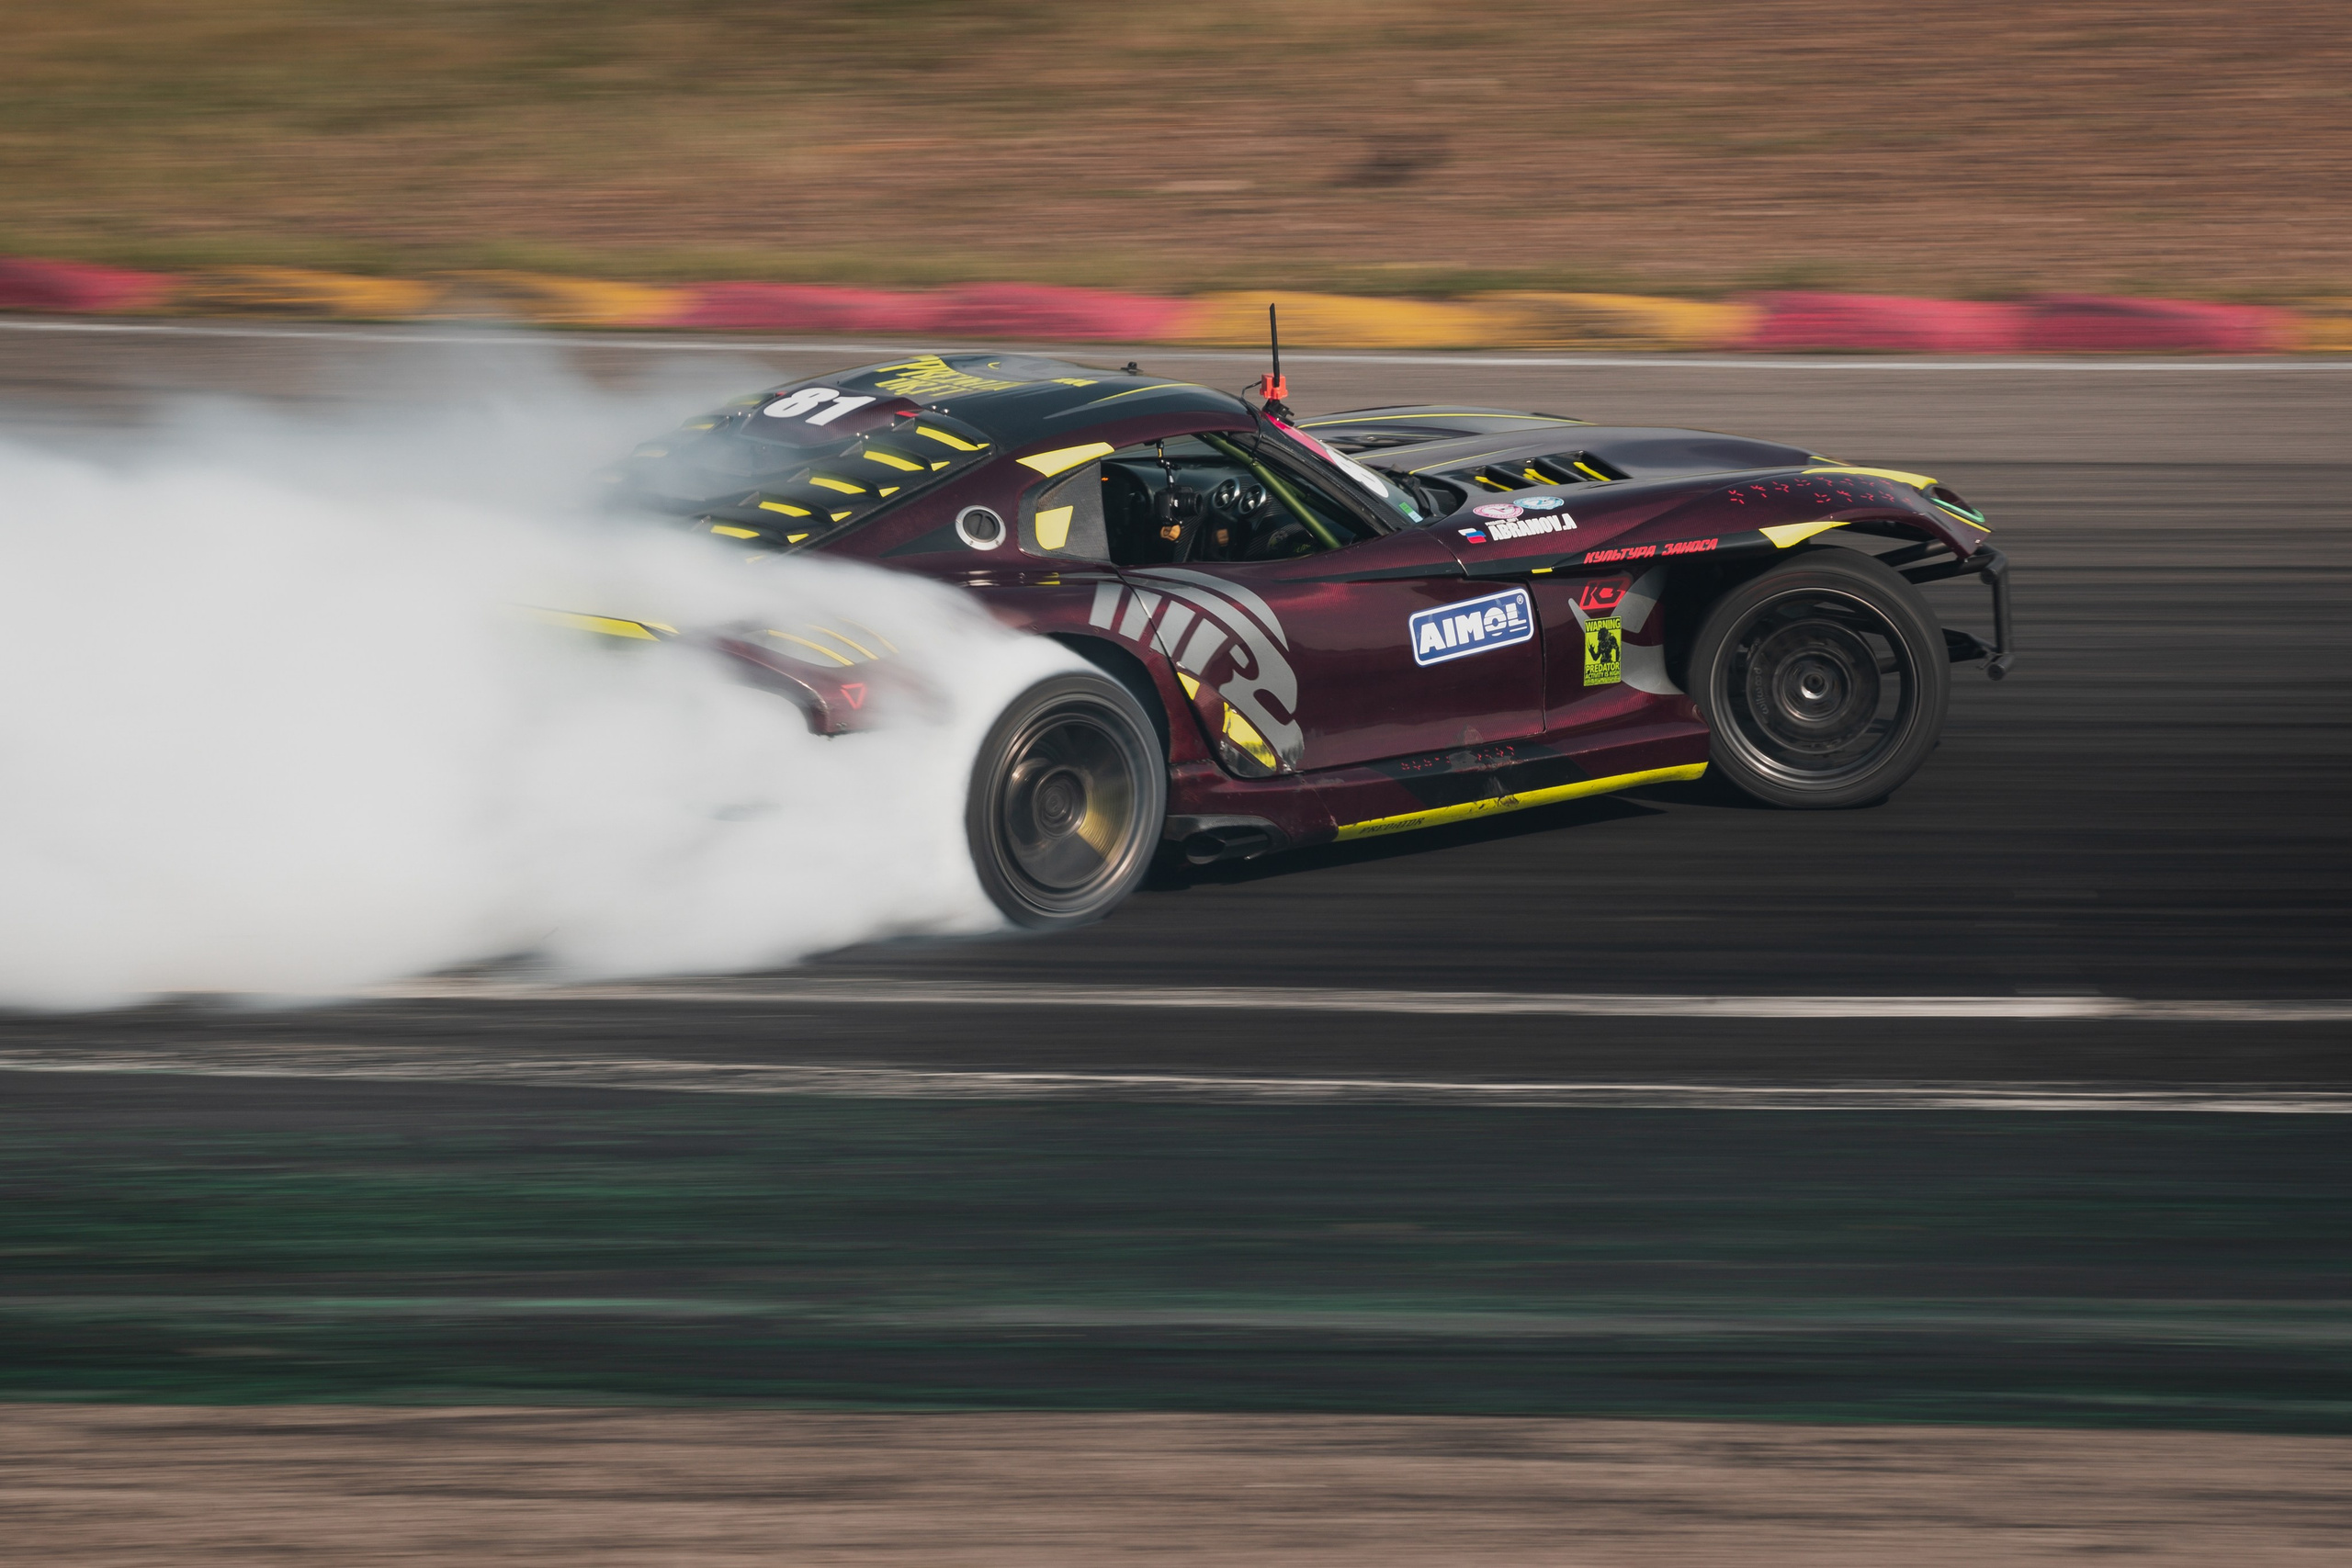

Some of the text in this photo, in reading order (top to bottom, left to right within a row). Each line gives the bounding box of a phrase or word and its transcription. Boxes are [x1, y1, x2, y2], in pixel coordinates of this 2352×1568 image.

[763, 387, 876, 426] 81
[1487, 513, 1577, 541] ABRAMOV.A
[1584, 537, 1719, 564] КУЛЬТУРА ЗАНОСА
[1585, 618, 1621, 633] WARNING
[1585, 662, 1620, 674] PREDATOR
